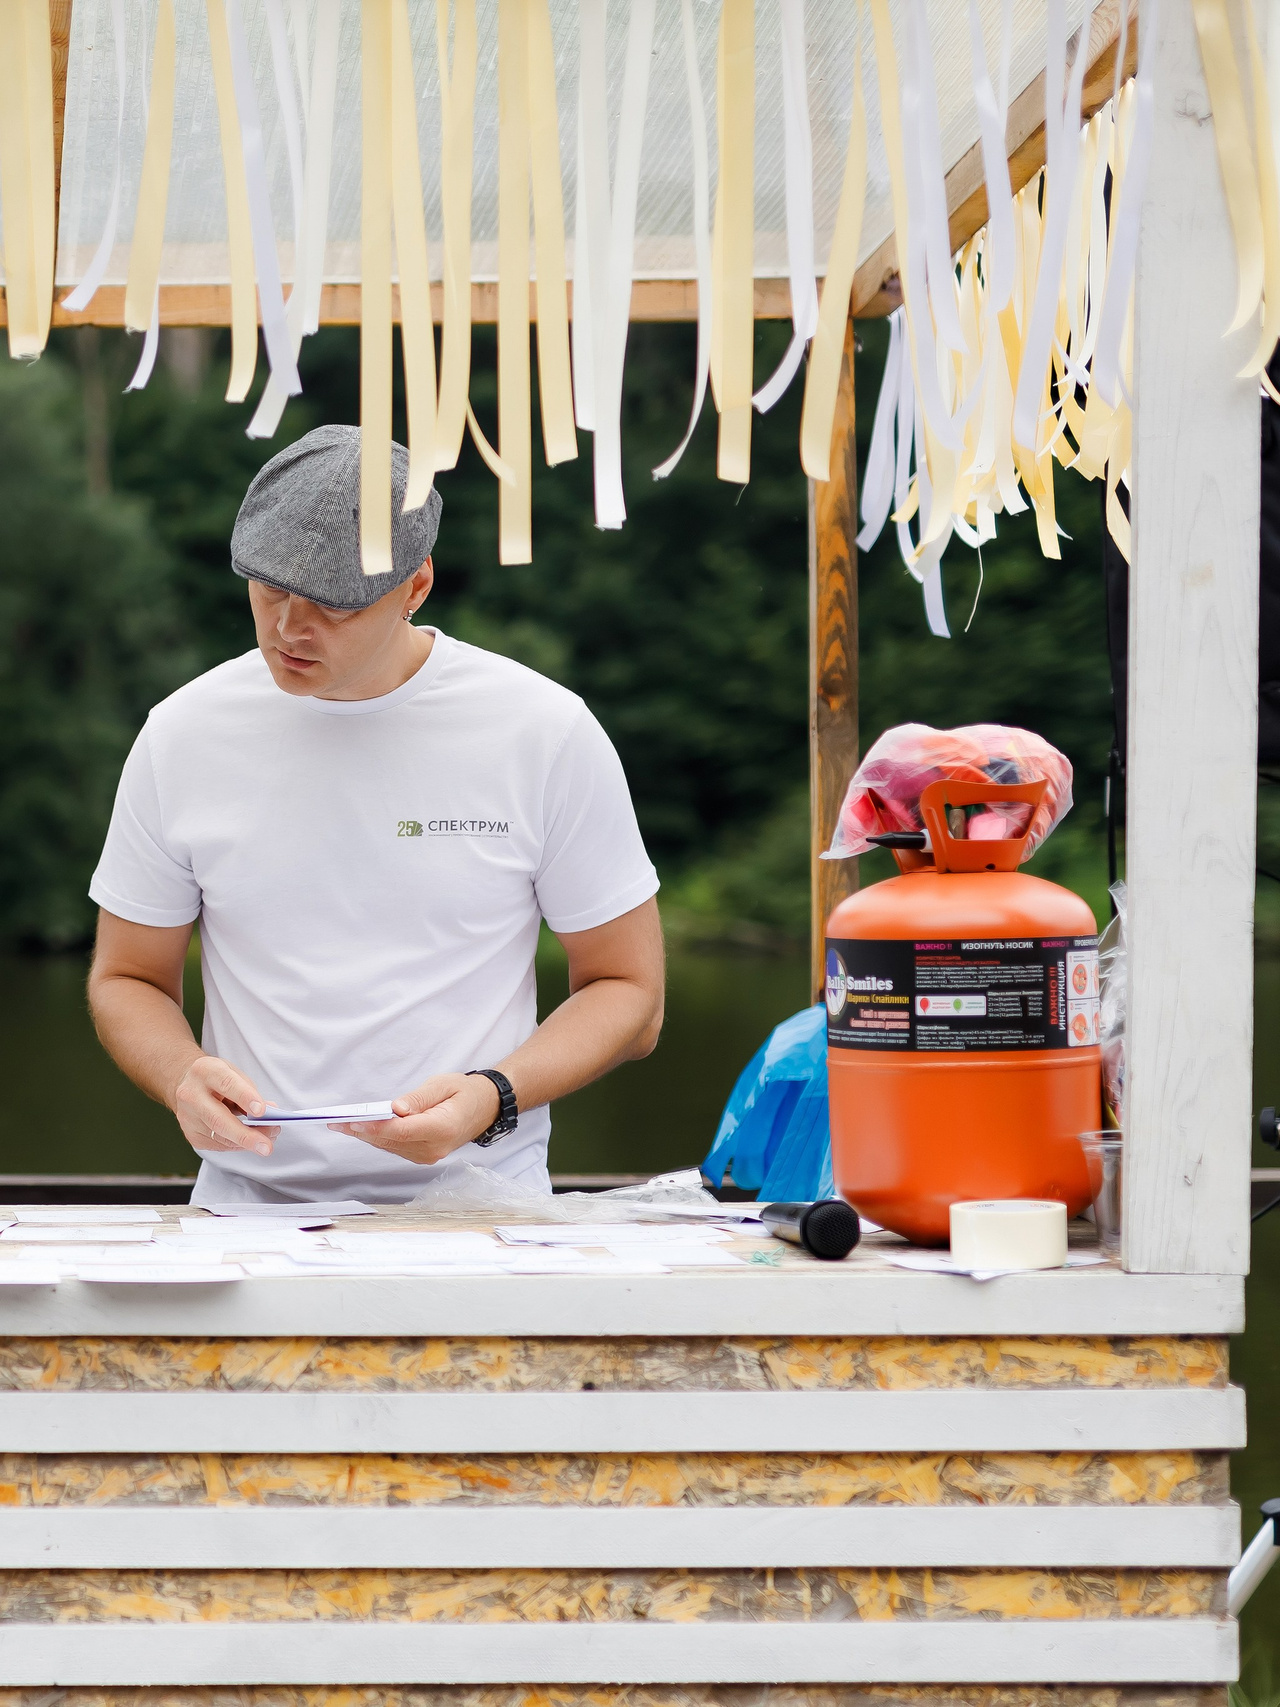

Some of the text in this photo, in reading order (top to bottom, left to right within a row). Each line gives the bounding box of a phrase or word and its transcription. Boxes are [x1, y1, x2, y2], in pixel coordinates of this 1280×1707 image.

[428, 820, 509, 833] СПЕКТРУМ
[961, 942, 1004, 950] ИЗОГНУТЬ
[1005, 941, 1034, 949] НОСИК
[847, 976, 893, 991] Smiles
[872, 994, 909, 1004] Смайлики
[1050, 979, 1058, 1025] ВАЖНО
[1057, 961, 1066, 1031] ИНСТРУКЦИЯ
